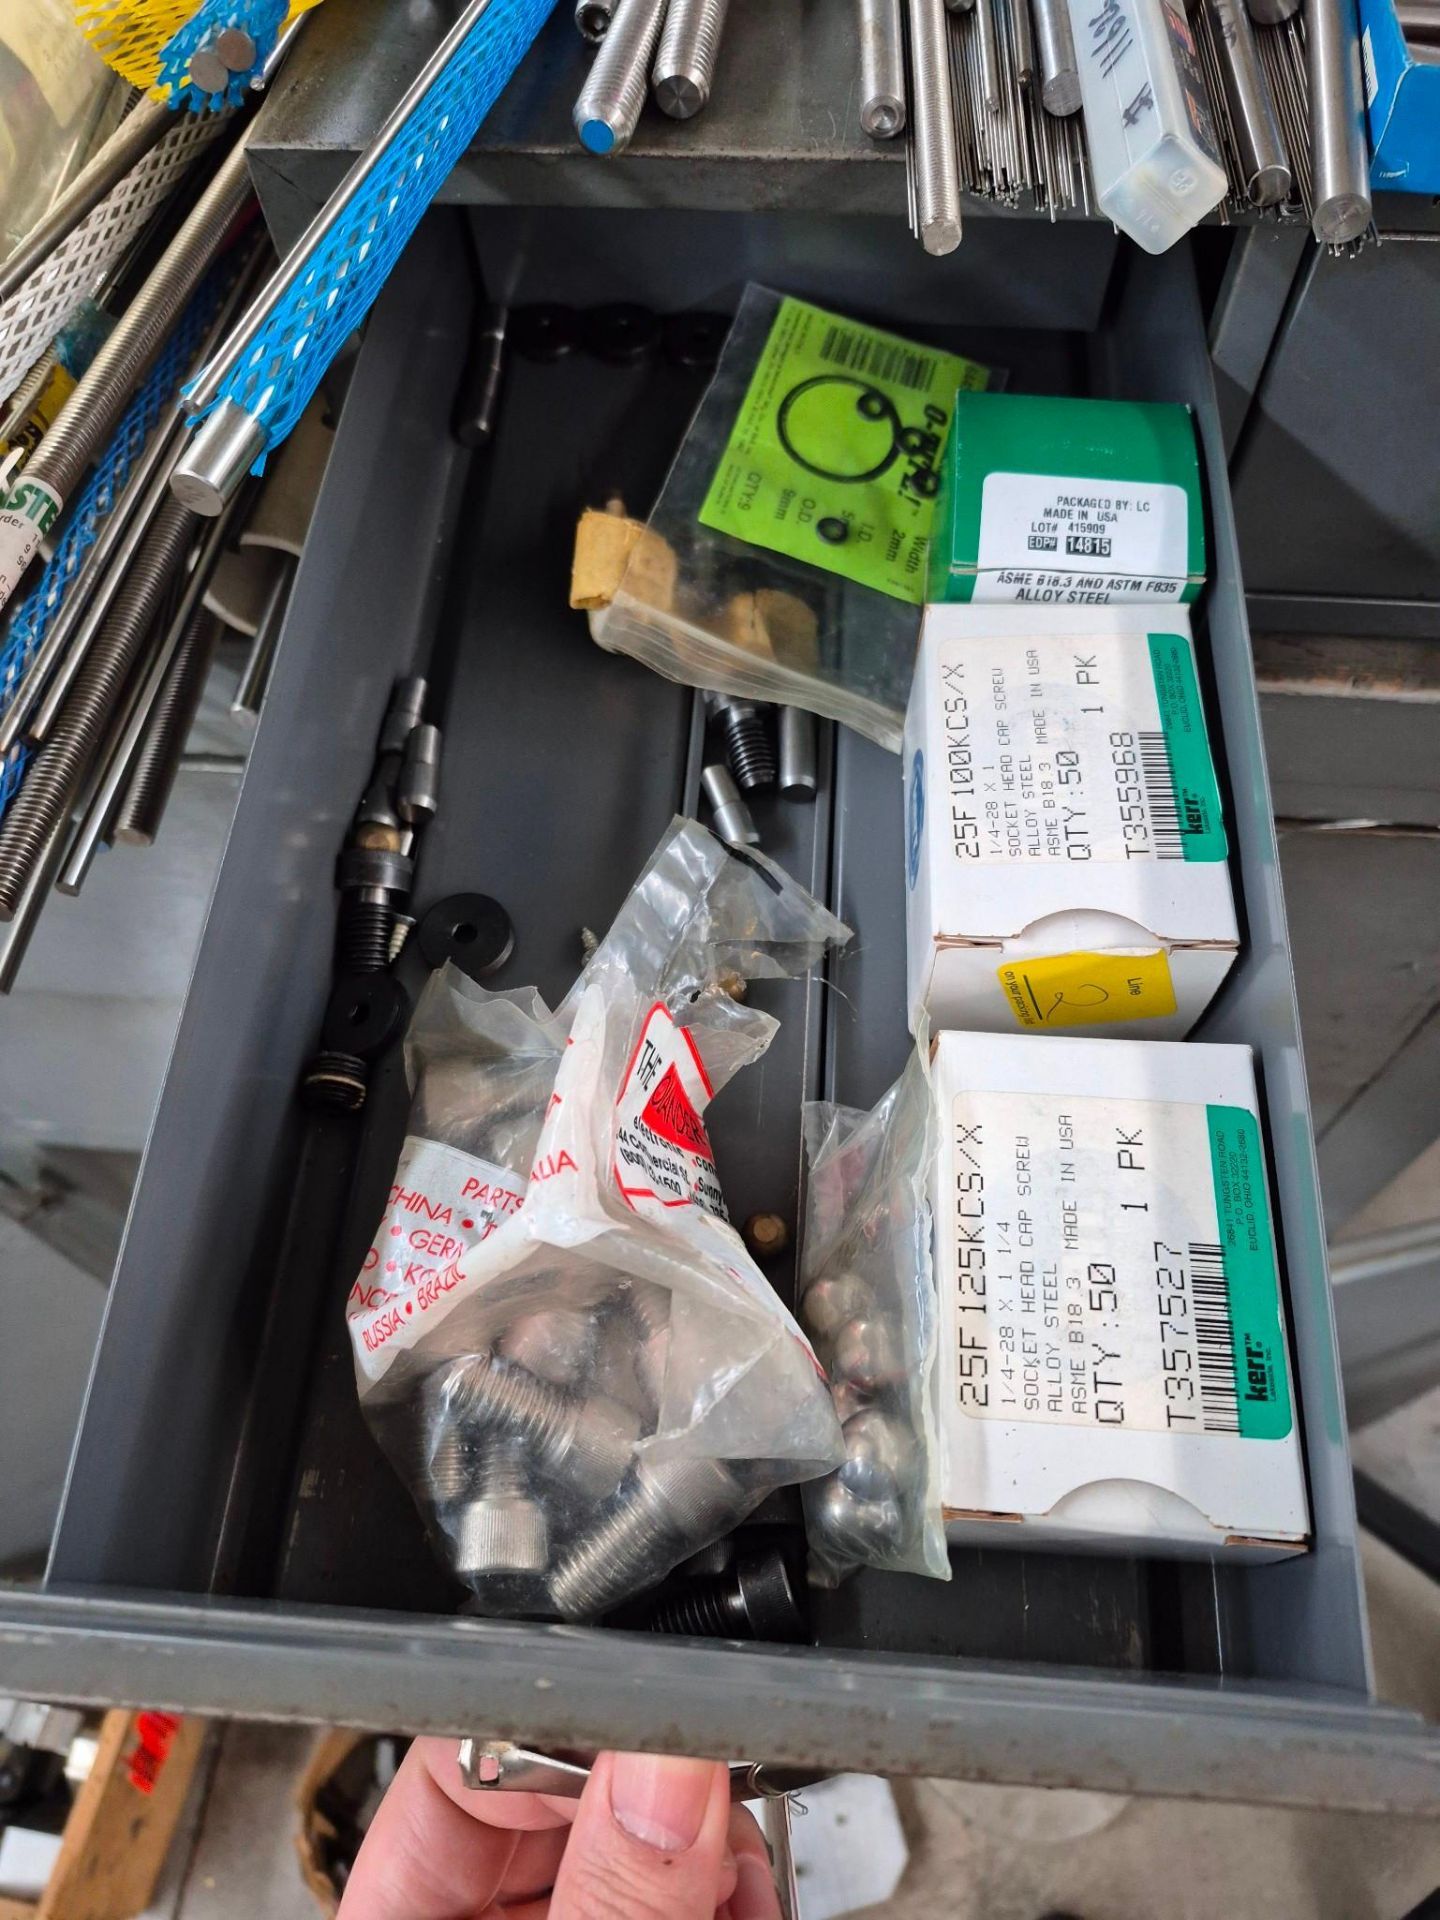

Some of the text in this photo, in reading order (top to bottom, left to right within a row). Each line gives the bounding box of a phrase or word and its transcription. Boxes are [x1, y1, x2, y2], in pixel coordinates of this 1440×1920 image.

[1043, 508, 1118, 523] MADE IN USA
[1057, 496, 1111, 510] PACKAGED
[1136, 501, 1150, 512] LC
[885, 528, 905, 562] 2mm
[1031, 522, 1106, 534] LOT# 415909
[906, 536, 928, 575] Width
[1028, 537, 1111, 556] EDP# 14815
[997, 572, 1033, 586] ASME
[1076, 577, 1103, 590] AND
[1106, 578, 1142, 592] ASTM
[1015, 588, 1111, 604] ALLOY STEEL
[1026, 650, 1039, 674] USA
[1074, 655, 1100, 684] PK
[1030, 683, 1043, 696] IN
[1032, 710, 1048, 744] MADE
[992, 668, 1022, 856] SOCKET HEAD CAP SCREW
[984, 783, 996, 792] X
[1109, 732, 1150, 860] T355968
[1019, 755, 1041, 856] ALLOY STEEL
[985, 801, 1002, 854] 1/4-28
[1045, 818, 1061, 856] ASME
[1127, 977, 1141, 997] Line
[636, 1039, 662, 1092] THE
[1058, 1115, 1073, 1150] USA
[1216, 1130, 1226, 1158] ROAD
[1060, 1163, 1075, 1182] IN
[1116, 1128, 1148, 1211] 1 PK
[1219, 1161, 1232, 1213] TUNGSTEN
[1233, 1182, 1242, 1202] BOX
[996, 1222, 1011, 1254] 1/4
[1062, 1200, 1078, 1249] MADE
[1016, 1136, 1039, 1410] SOCKET HEAD CAP SCREW
[362, 1308, 406, 1351] RUSSIA
[417, 1263, 466, 1311] BRAZIL
[998, 1299, 1012, 1311] X
[1043, 1263, 1062, 1412] ALLOY STEEL
[1154, 1242, 1195, 1428] T357527
[999, 1326, 1015, 1404] 1/4-28
[1245, 1347, 1268, 1401] kerr
[1070, 1359, 1087, 1414] ASME
